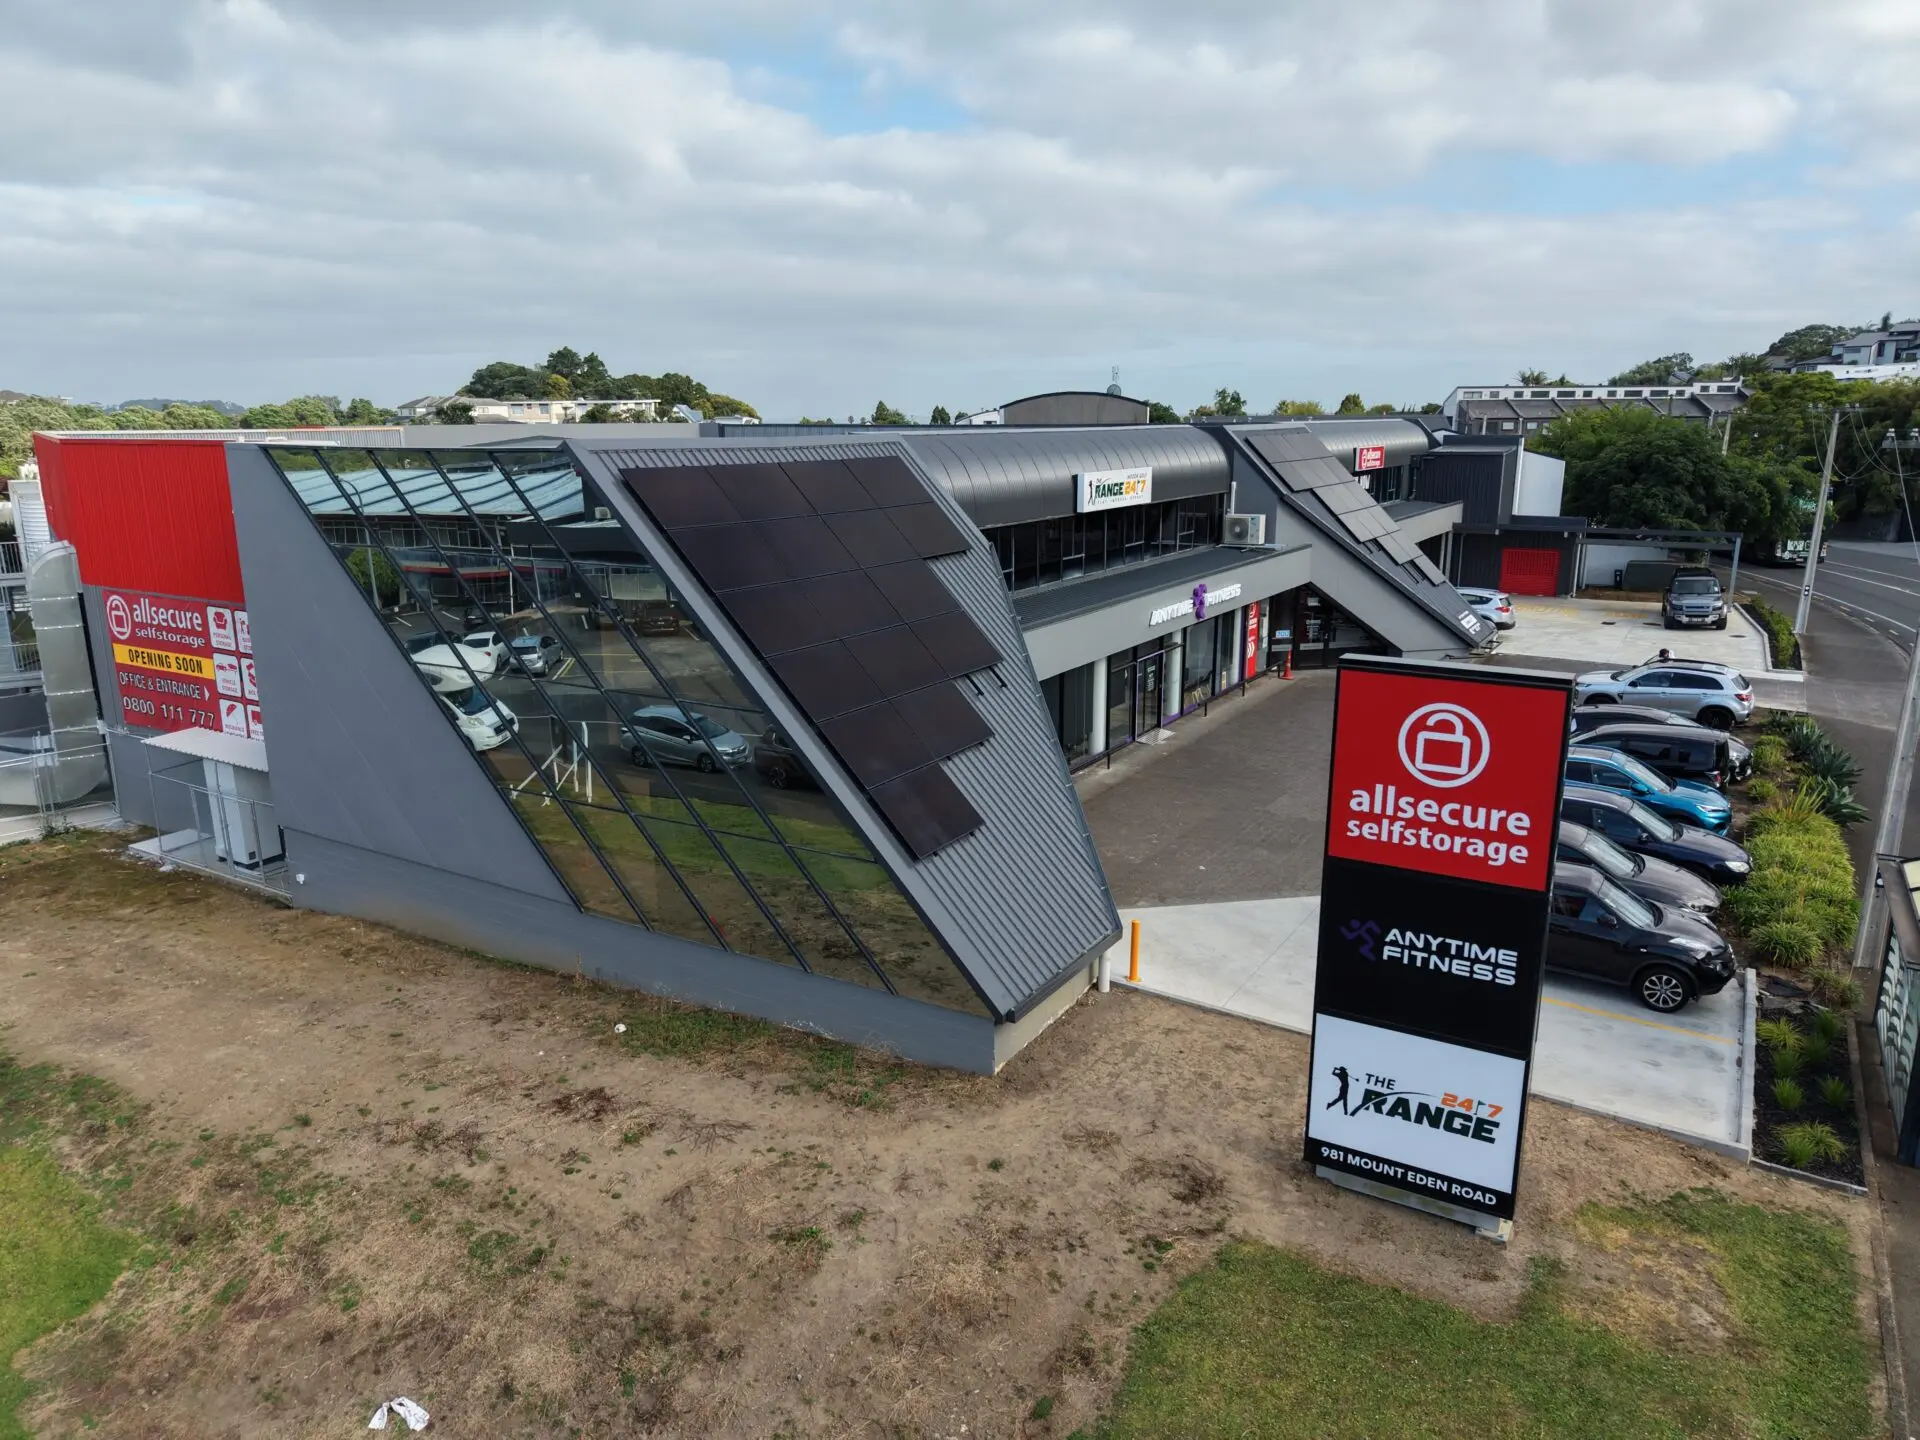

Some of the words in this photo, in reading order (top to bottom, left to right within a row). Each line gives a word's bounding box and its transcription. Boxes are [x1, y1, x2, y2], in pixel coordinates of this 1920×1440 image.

[1095, 482, 1124, 498] RANGE
[1205, 584, 1241, 606] FITNESS
[132, 598, 202, 631] allsecure
[1149, 599, 1193, 626] ANYTIME
[135, 627, 205, 648] selfstorage
[128, 649, 171, 668] OPENING
[175, 656, 203, 674] SOON
[119, 672, 146, 689] OFFICE
[147, 678, 154, 690] &
[156, 678, 201, 699] ENTRANCE
[123, 696, 155, 715] 0800
[160, 704, 183, 720] 111
[189, 709, 214, 726] 777
[1350, 783, 1531, 836] allsecure
[1346, 818, 1529, 866] selfstorage
[1384, 928, 1518, 967] ANYTIME
[1382, 945, 1516, 986] FITNESS
[1365, 1073, 1396, 1091] THE
[1354, 1088, 1500, 1144] RANGE
[1320, 1146, 1344, 1162] 981
[1347, 1153, 1405, 1179] MOUNT
[1407, 1170, 1448, 1192] EDEN
[1451, 1183, 1497, 1205] ROAD
